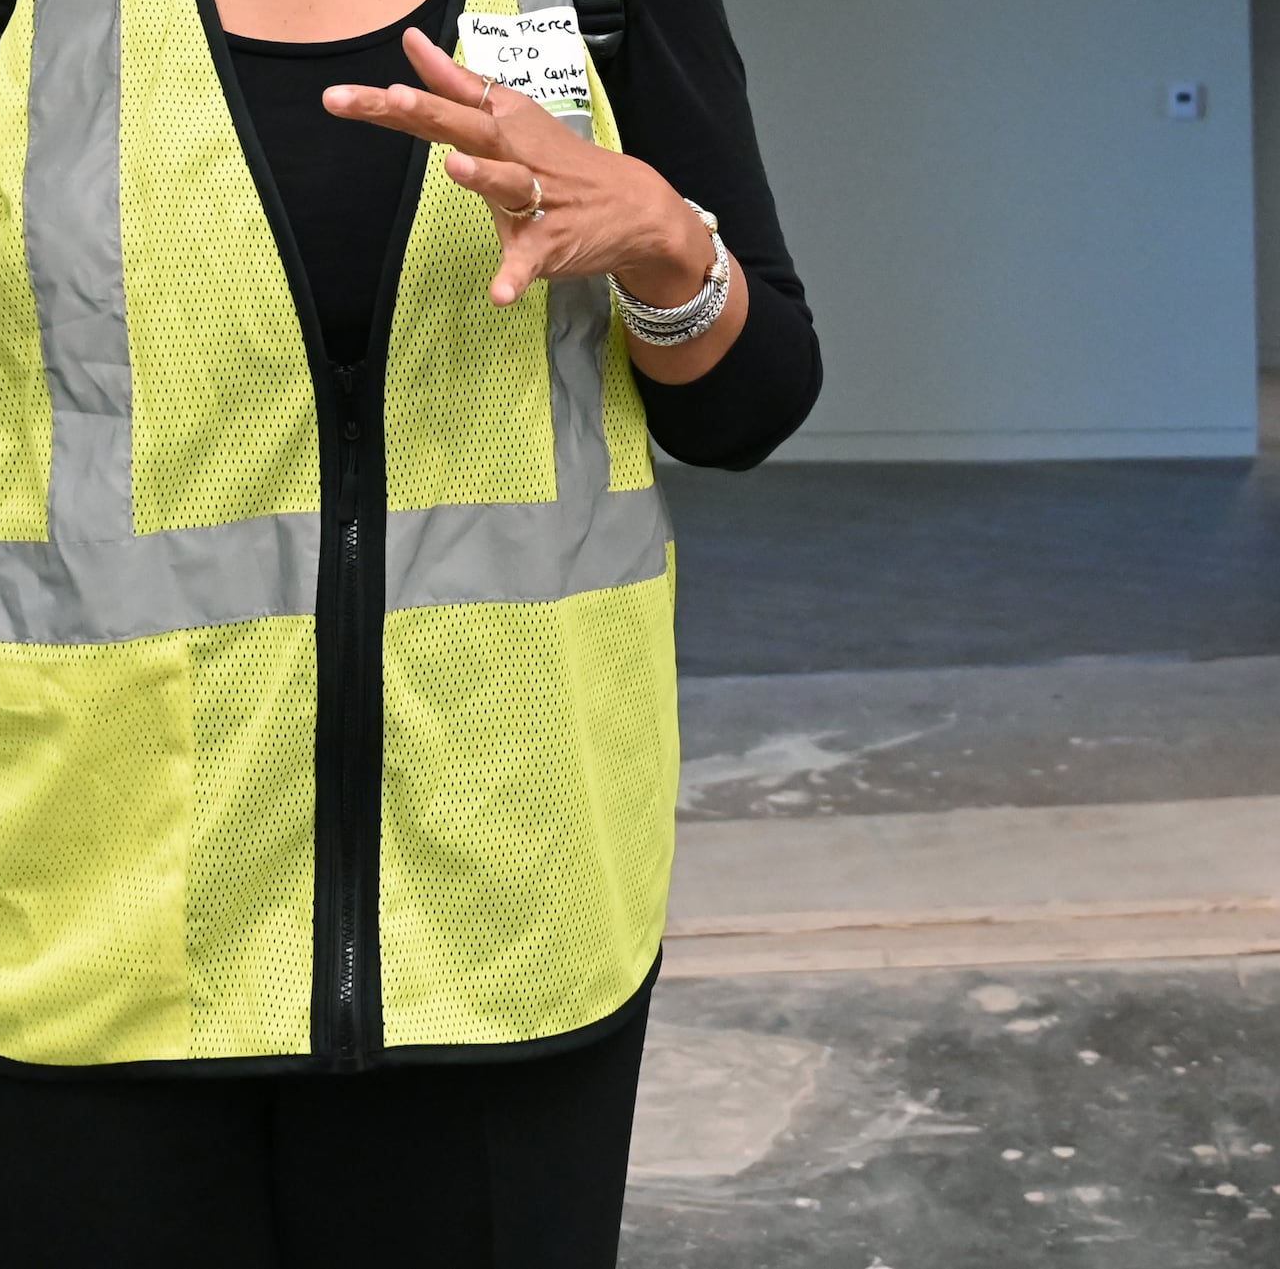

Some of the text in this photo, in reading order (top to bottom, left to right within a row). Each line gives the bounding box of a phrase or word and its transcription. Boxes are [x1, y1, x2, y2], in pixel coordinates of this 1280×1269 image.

[516, 18, 576, 36] Pierce
[497, 46, 540, 63] CPO
[544, 64, 585, 81] Center
